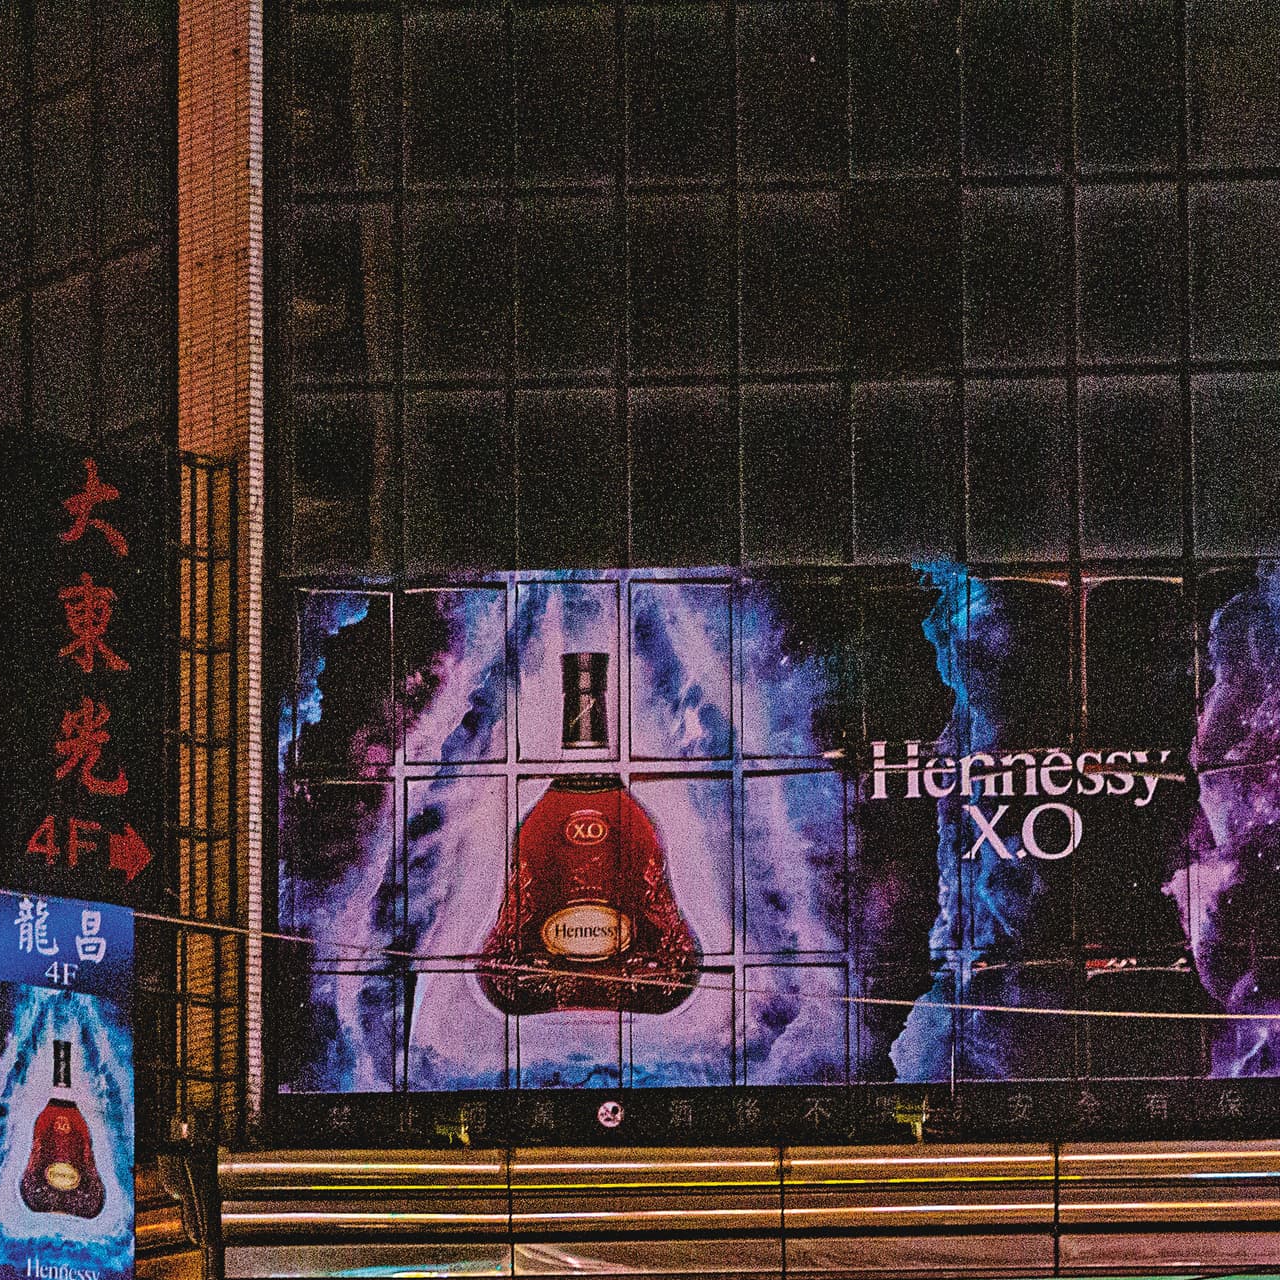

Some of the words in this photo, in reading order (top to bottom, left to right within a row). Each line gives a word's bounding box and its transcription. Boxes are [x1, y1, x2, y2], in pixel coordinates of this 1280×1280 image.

[870, 739, 1172, 806] Hennessy
[26, 815, 101, 869] 4F
[13, 898, 108, 965] 龍昌
[44, 961, 79, 988] 4F
